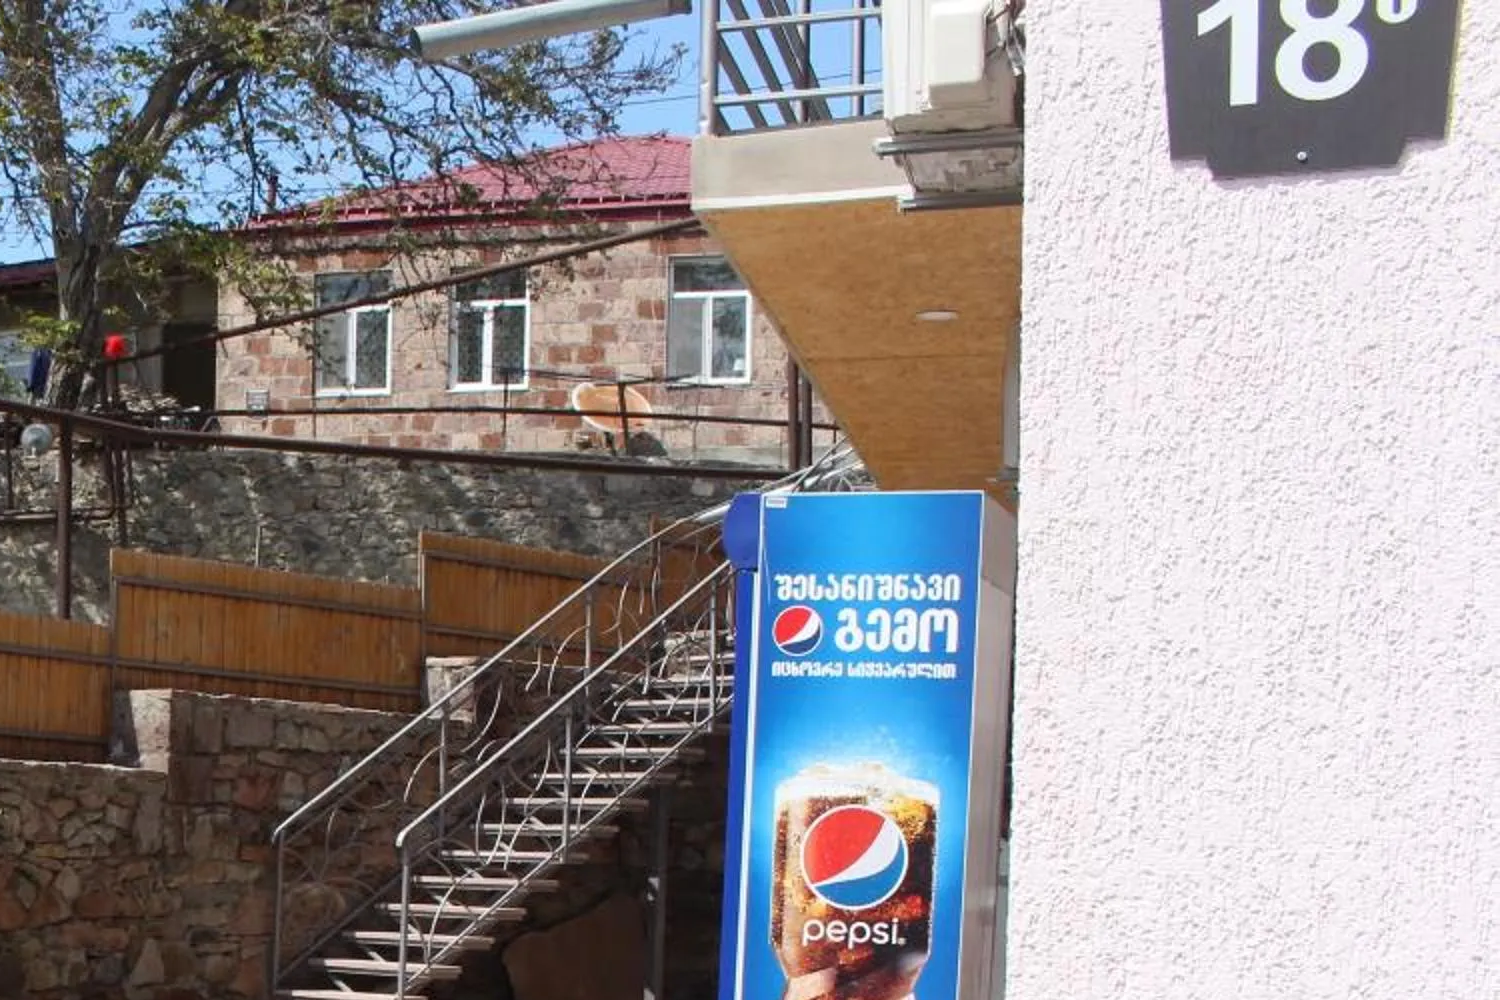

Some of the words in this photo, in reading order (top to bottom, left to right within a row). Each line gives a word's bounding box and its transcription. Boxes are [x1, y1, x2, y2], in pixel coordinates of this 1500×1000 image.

[774, 573, 962, 602] შესანიშნავი
[833, 606, 960, 654] გემო
[802, 917, 899, 950] pepsi
